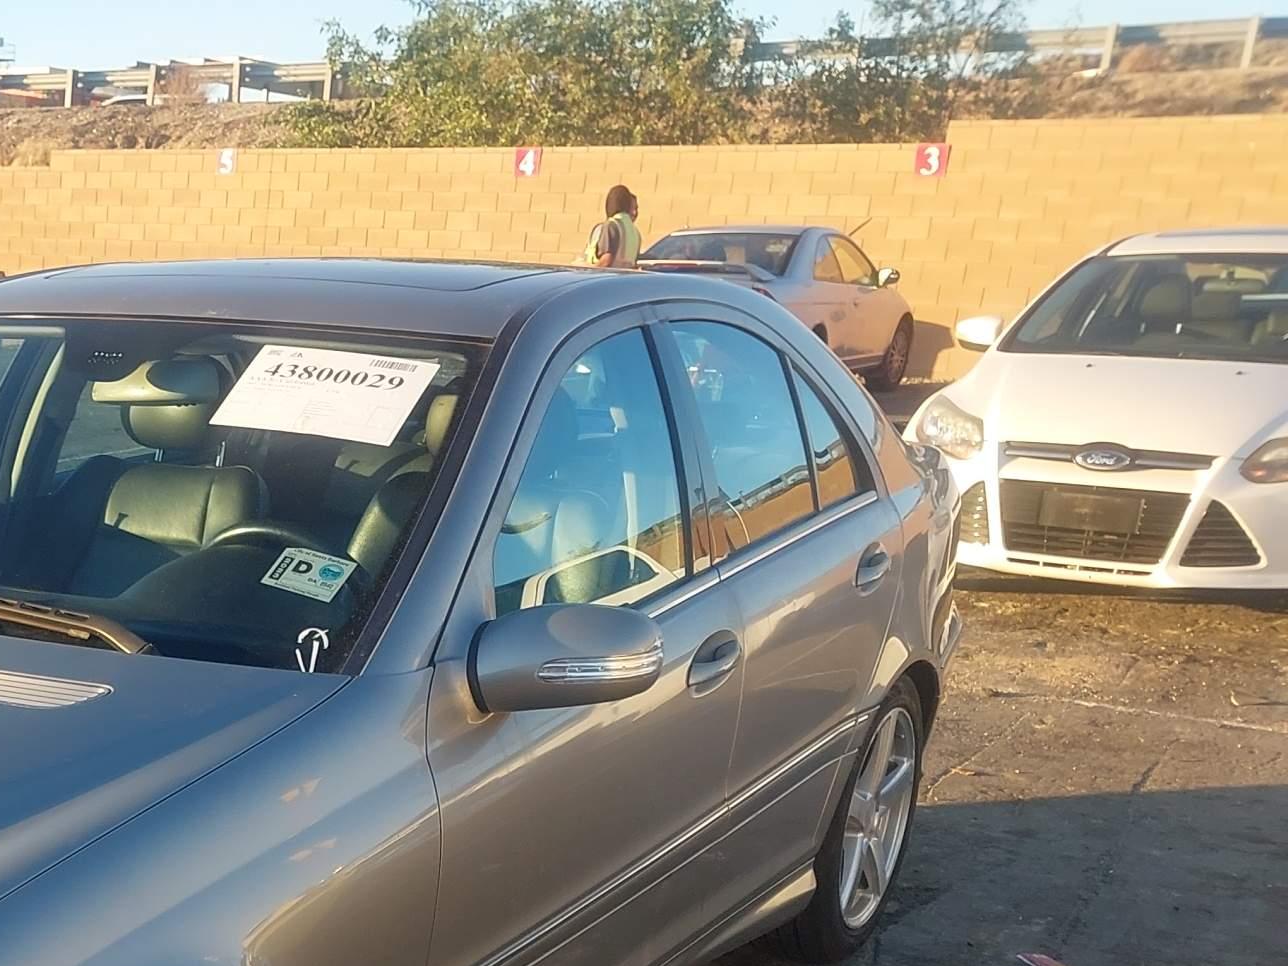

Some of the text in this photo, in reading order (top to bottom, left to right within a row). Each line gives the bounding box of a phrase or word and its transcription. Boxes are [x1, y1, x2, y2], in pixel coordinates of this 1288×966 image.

[218, 148, 233, 176] 5
[518, 149, 536, 176] 4
[919, 146, 940, 176] 3
[264, 362, 405, 391] 43800029
[292, 560, 313, 574] D
